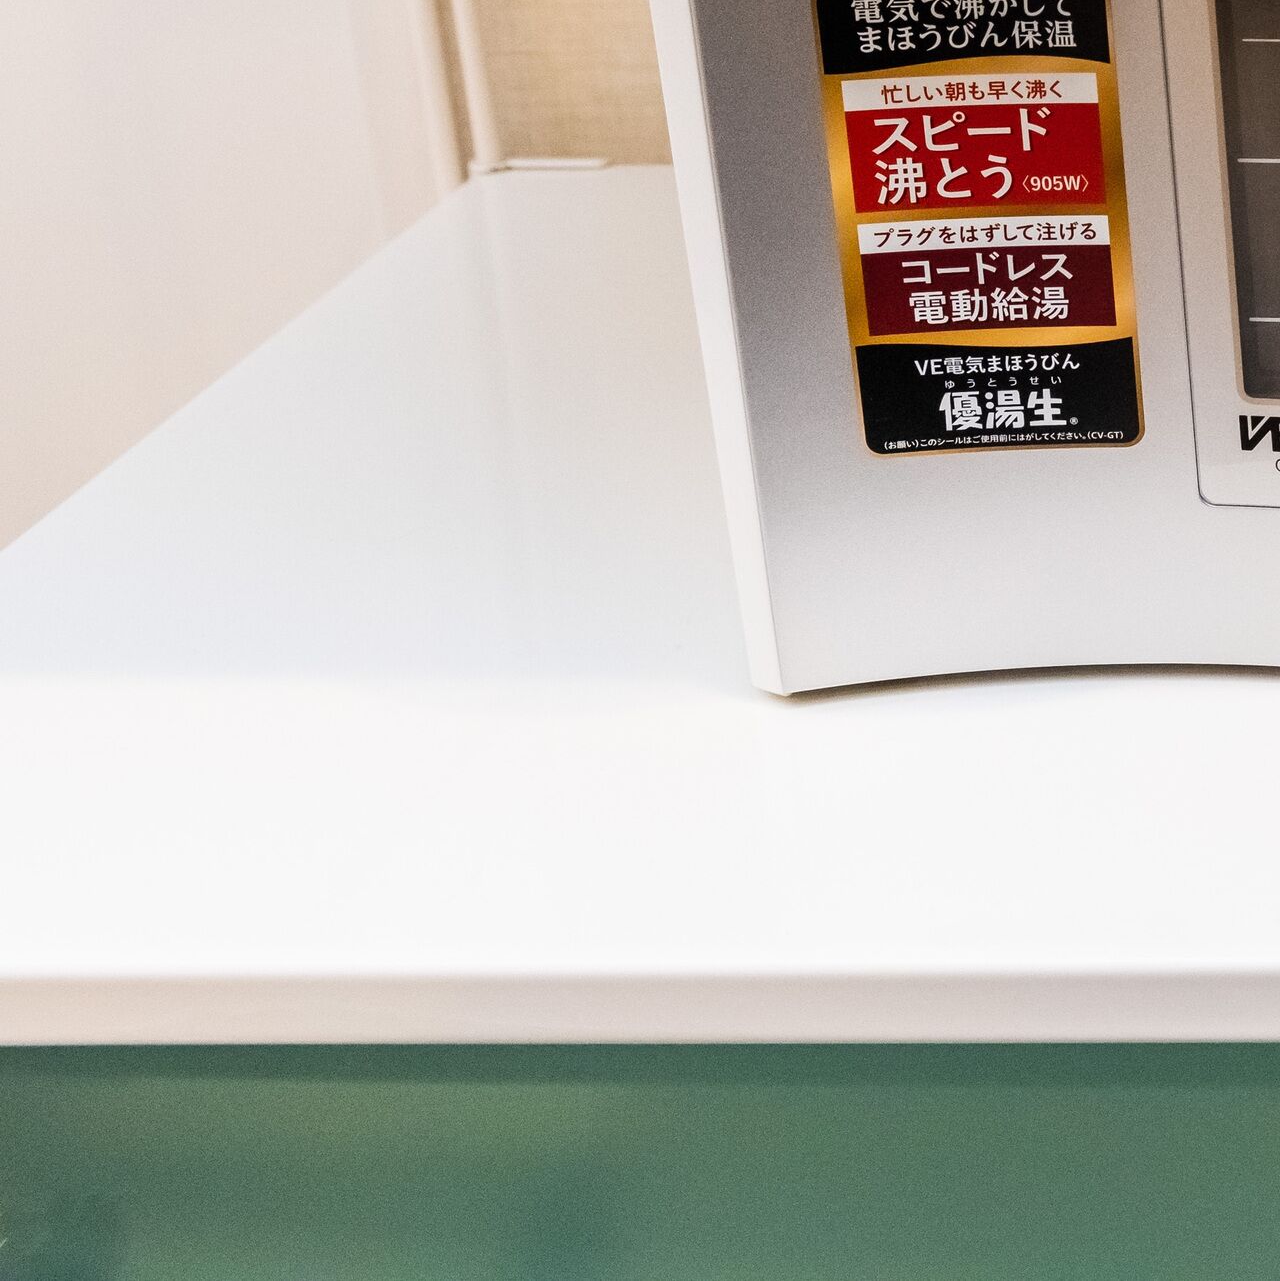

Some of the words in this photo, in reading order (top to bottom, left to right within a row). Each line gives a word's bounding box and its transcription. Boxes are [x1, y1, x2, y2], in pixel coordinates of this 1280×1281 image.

[856, 20, 1077, 54] まほうびん保温
[881, 79, 1063, 105] 忙しい朝も早く沸く
[872, 106, 1051, 155] スピード
[874, 154, 1012, 206] 沸とう
[873, 222, 1097, 248] プラグをはずして注げる
[901, 251, 1074, 285] コードレス
[908, 285, 1070, 325] 電動給湯
[914, 352, 1080, 376] VE電気まほうびん
